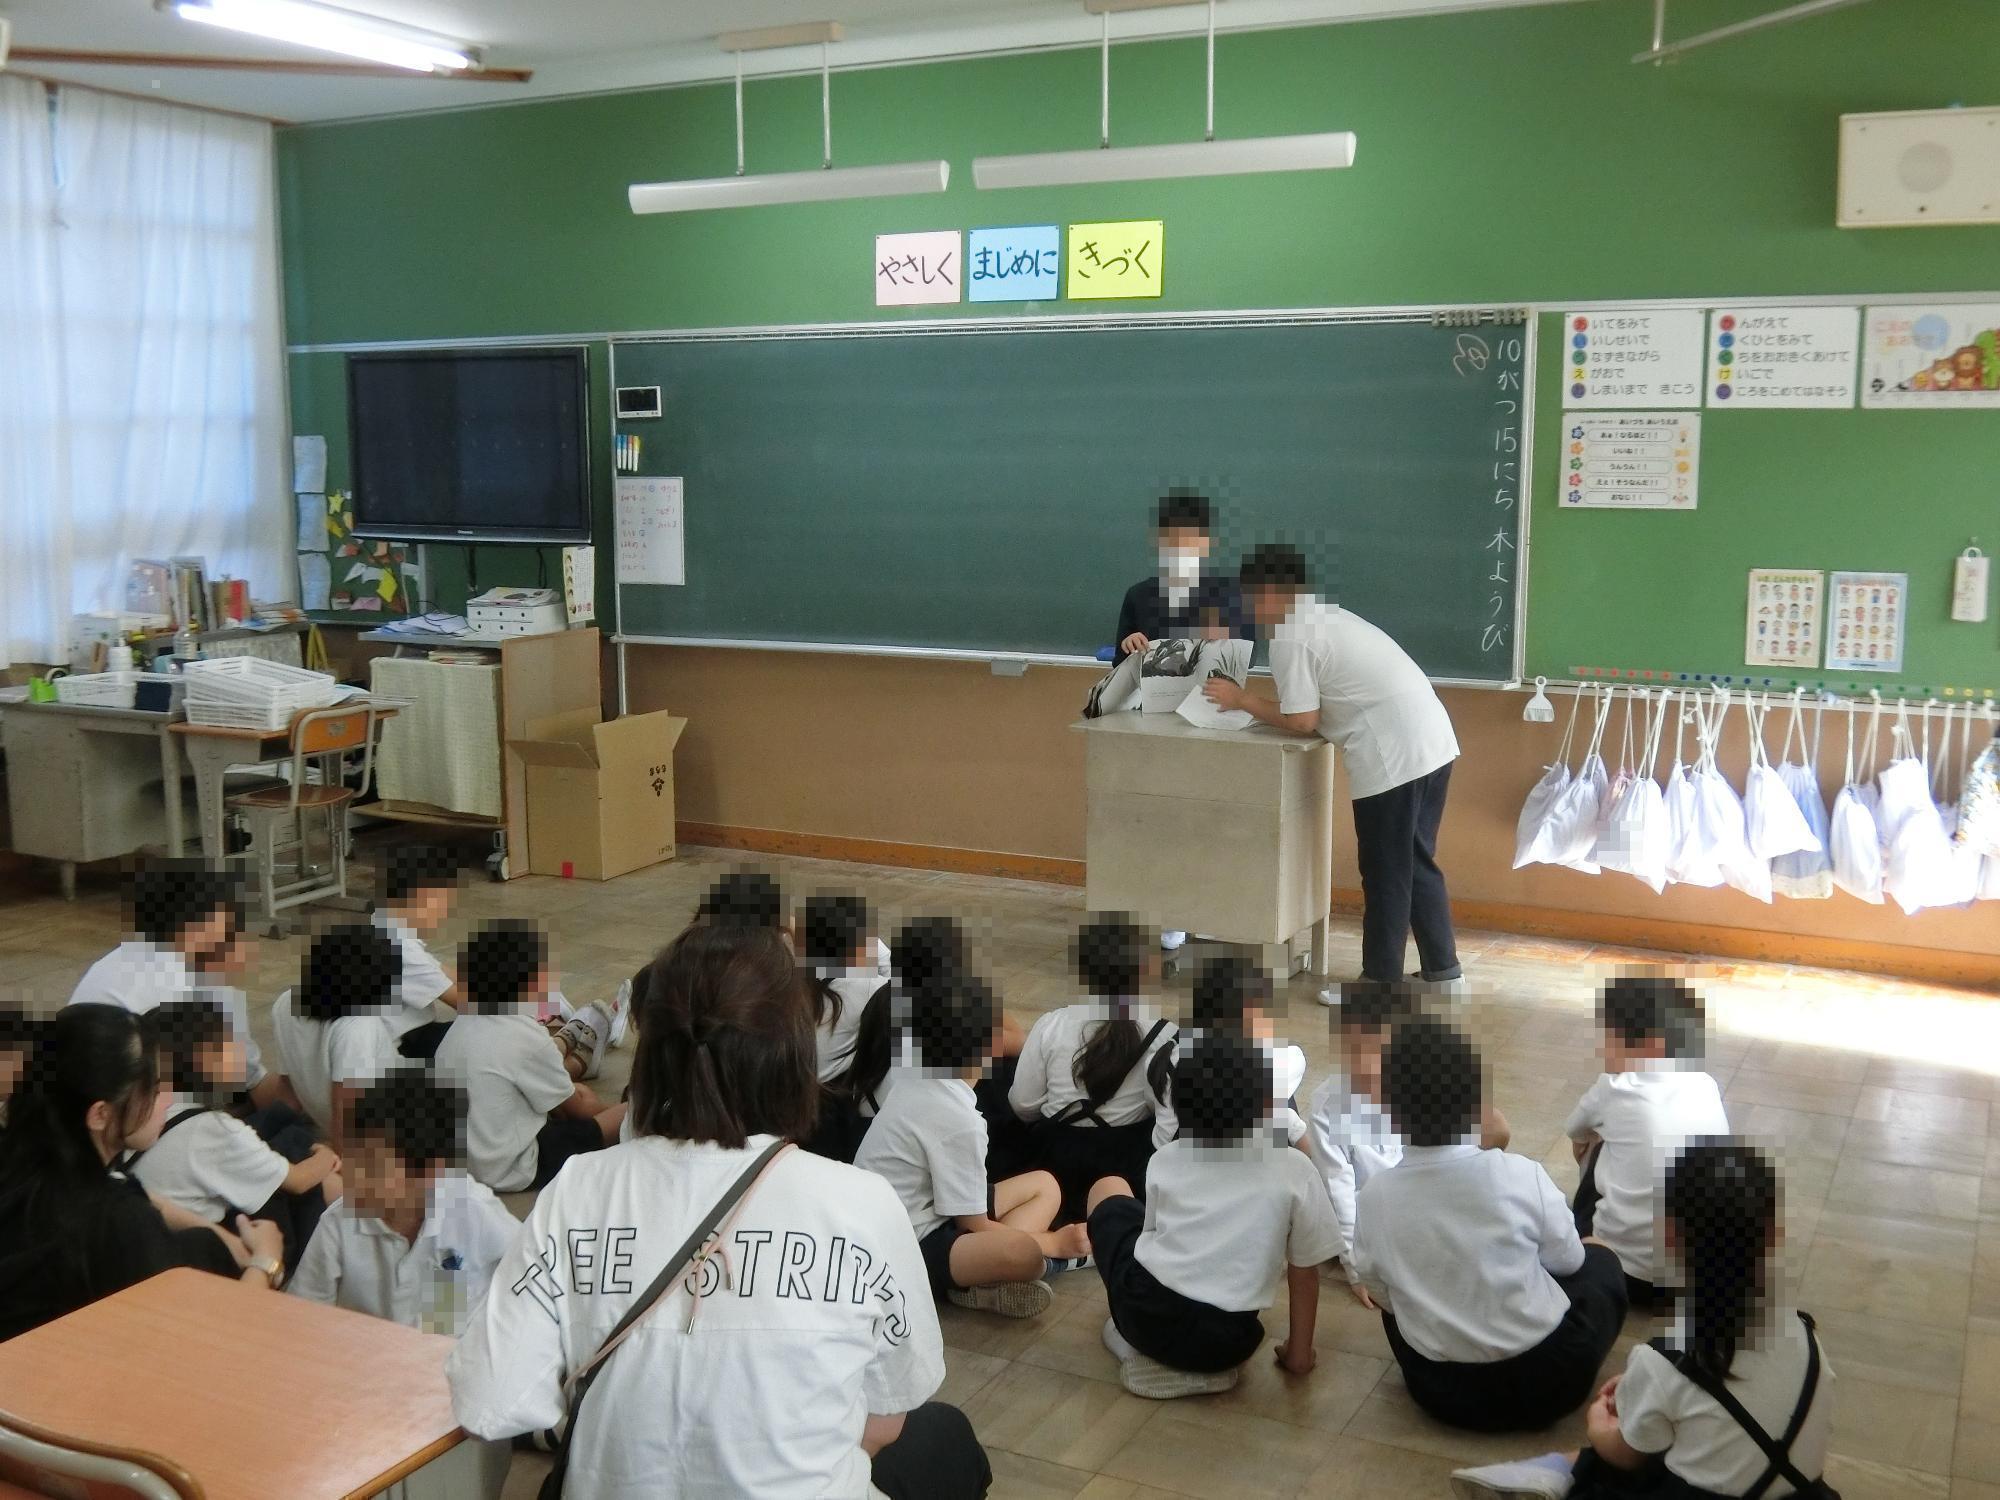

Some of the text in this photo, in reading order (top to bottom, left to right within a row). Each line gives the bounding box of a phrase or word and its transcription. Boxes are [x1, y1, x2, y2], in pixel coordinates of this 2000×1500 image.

[878, 251, 953, 286] やさしく
[972, 246, 1057, 281] まじめに
[1078, 240, 1151, 279] きづく
